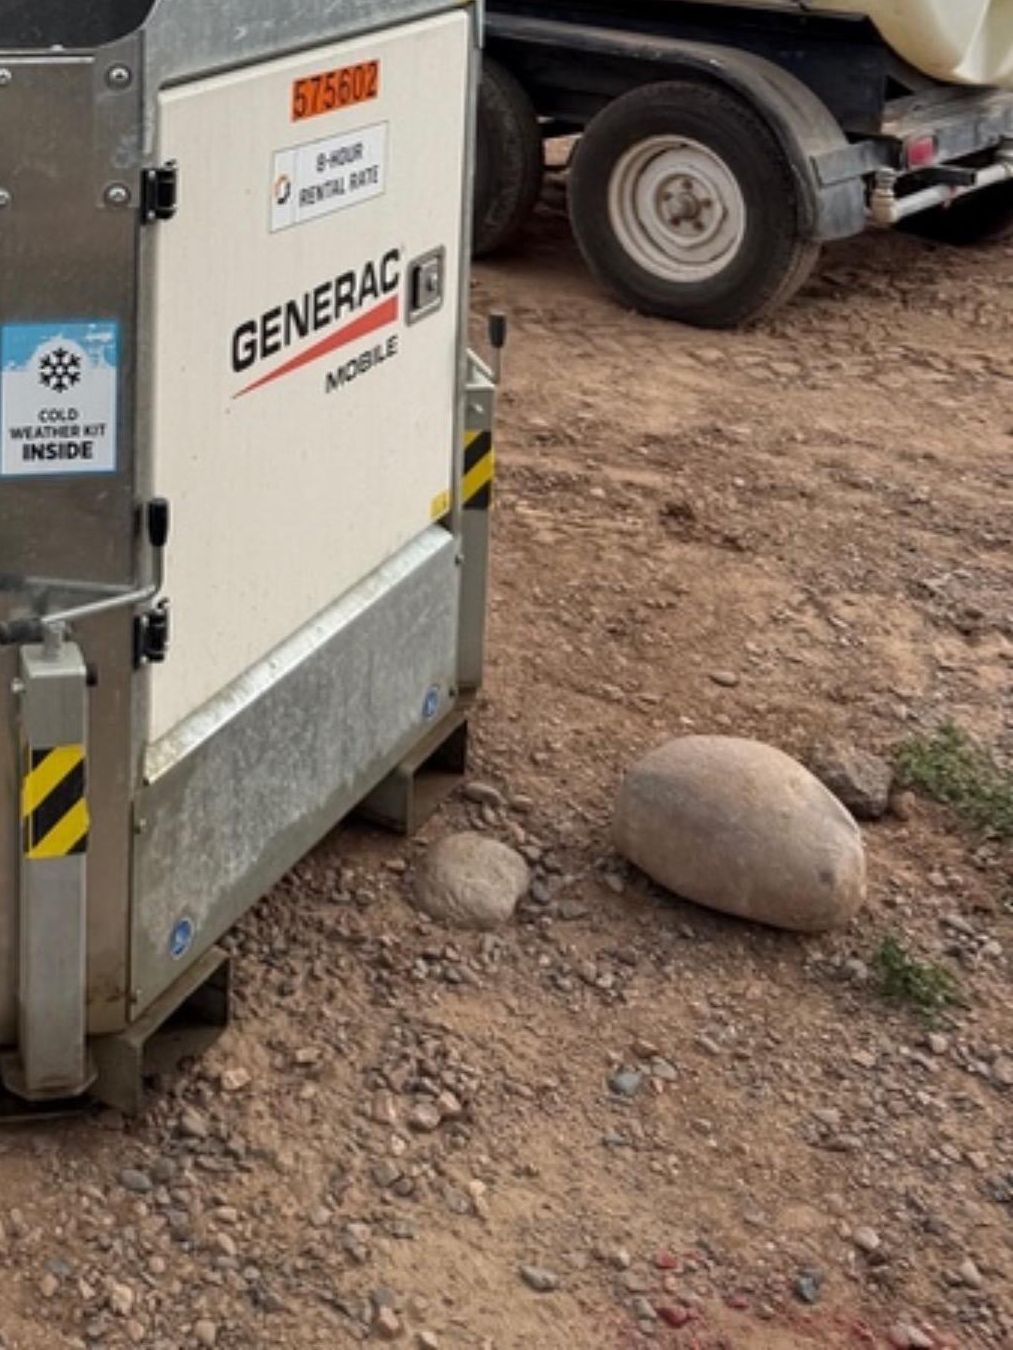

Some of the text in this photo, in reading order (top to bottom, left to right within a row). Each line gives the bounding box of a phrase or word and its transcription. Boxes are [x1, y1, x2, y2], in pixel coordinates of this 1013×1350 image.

[293, 62, 377, 120] 575602
[316, 142, 364, 174] 8-HOUR
[299, 164, 379, 208] RENTAL RATE
[231, 248, 400, 373] GENERAC
[324, 333, 399, 394] MOBILE
[9, 423, 106, 440] WEATHER KIT
[38, 408, 79, 423] COLD
[21, 441, 94, 461] INSIDE
